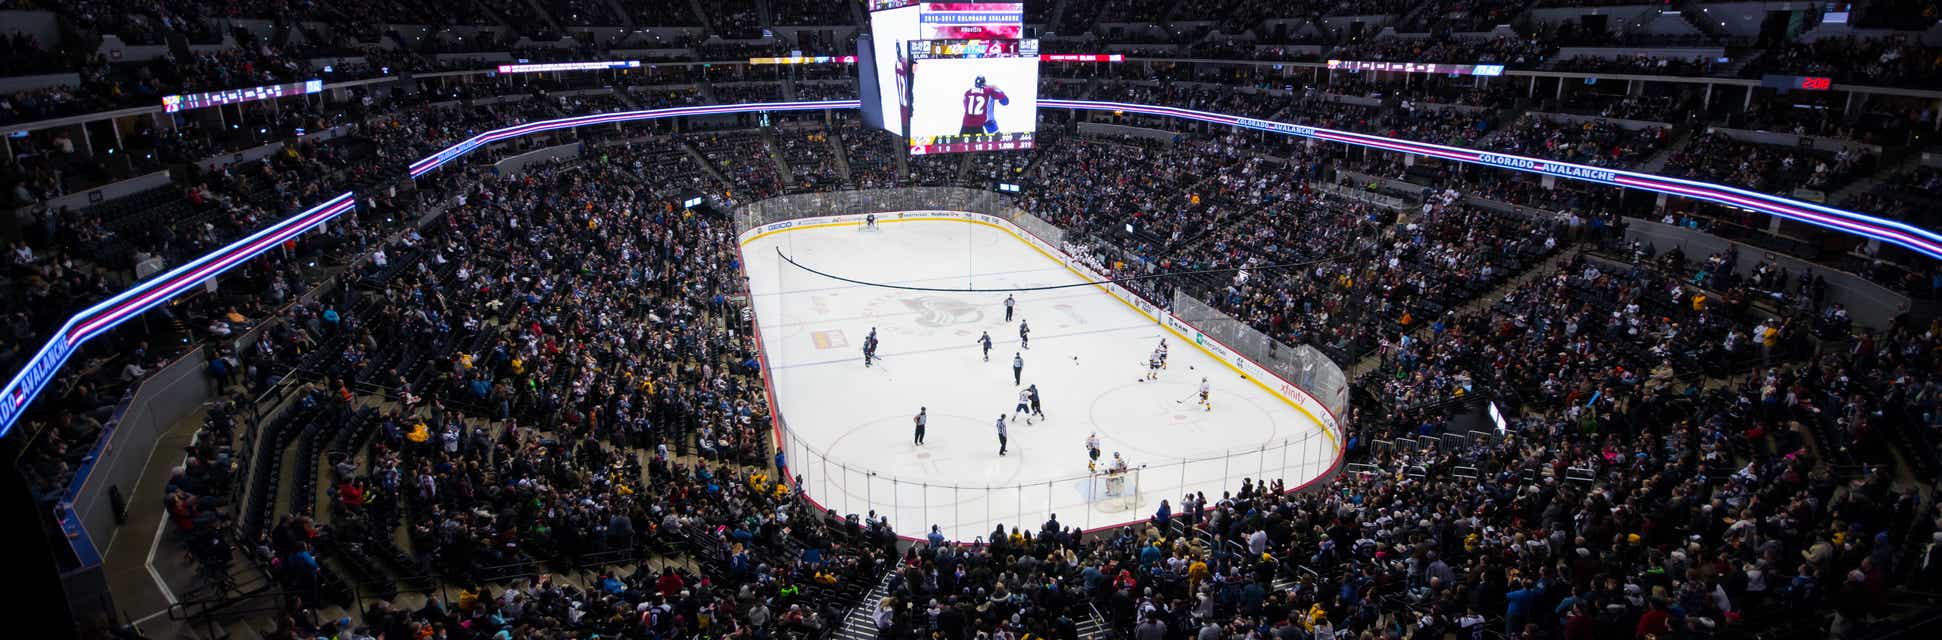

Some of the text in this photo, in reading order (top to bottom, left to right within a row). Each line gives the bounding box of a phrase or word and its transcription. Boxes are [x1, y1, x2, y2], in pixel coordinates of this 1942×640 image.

[967, 95, 985, 115] 12
[1237, 118, 1315, 136] COLORADO AVALANCHE
[1479, 154, 1616, 182] COLORADO AVALANCHE
[768, 221, 793, 231] GEICO
[21, 334, 69, 399] AVALANCHE
[1280, 383, 1306, 405] xfinity
